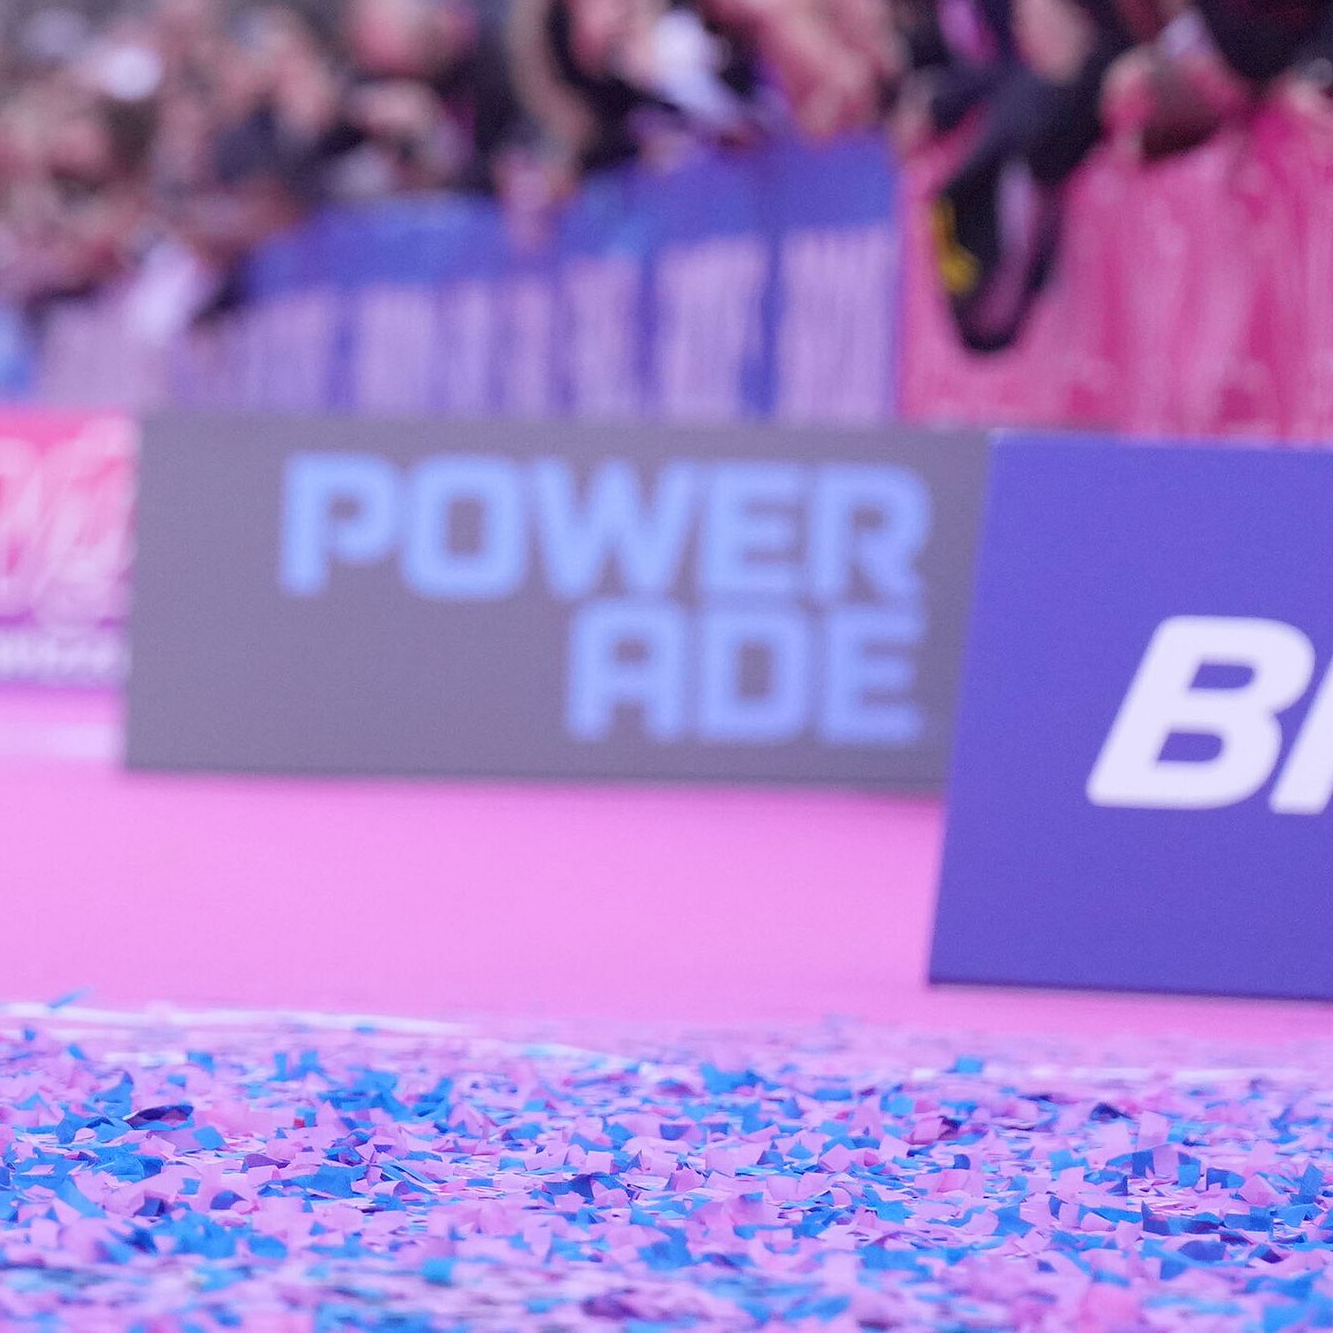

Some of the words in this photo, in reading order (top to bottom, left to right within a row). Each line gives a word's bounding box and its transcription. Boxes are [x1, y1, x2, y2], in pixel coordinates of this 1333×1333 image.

[277, 451, 931, 600] POWER
[564, 599, 926, 744] ADE
[1085, 614, 1333, 815] B
